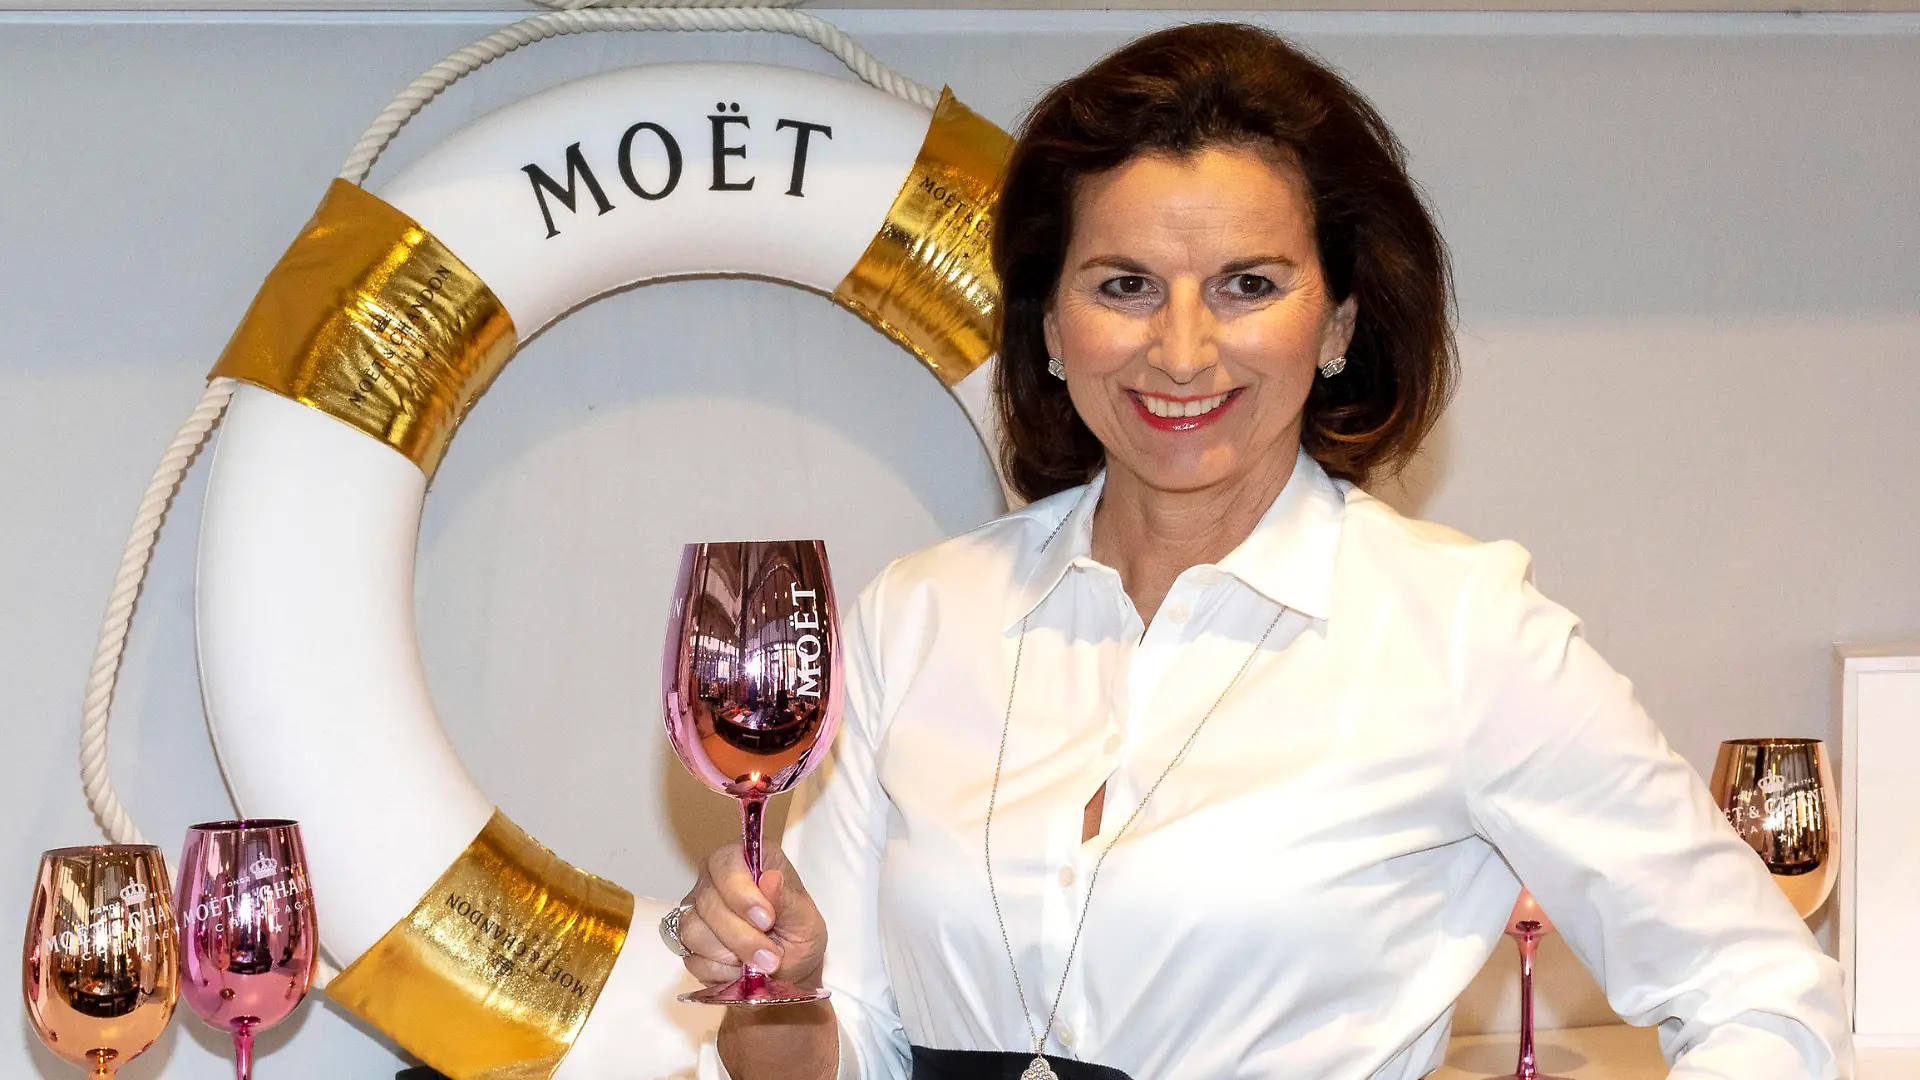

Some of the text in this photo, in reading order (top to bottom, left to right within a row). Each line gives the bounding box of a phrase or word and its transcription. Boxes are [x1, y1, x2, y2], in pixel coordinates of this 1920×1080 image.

[520, 102, 833, 240] MOËT
[390, 264, 452, 346] CHANDON
[790, 582, 821, 699] MOËT
[1749, 806, 1760, 819] &
[183, 895, 235, 928] MOËT
[445, 893, 527, 957] CHANDON
